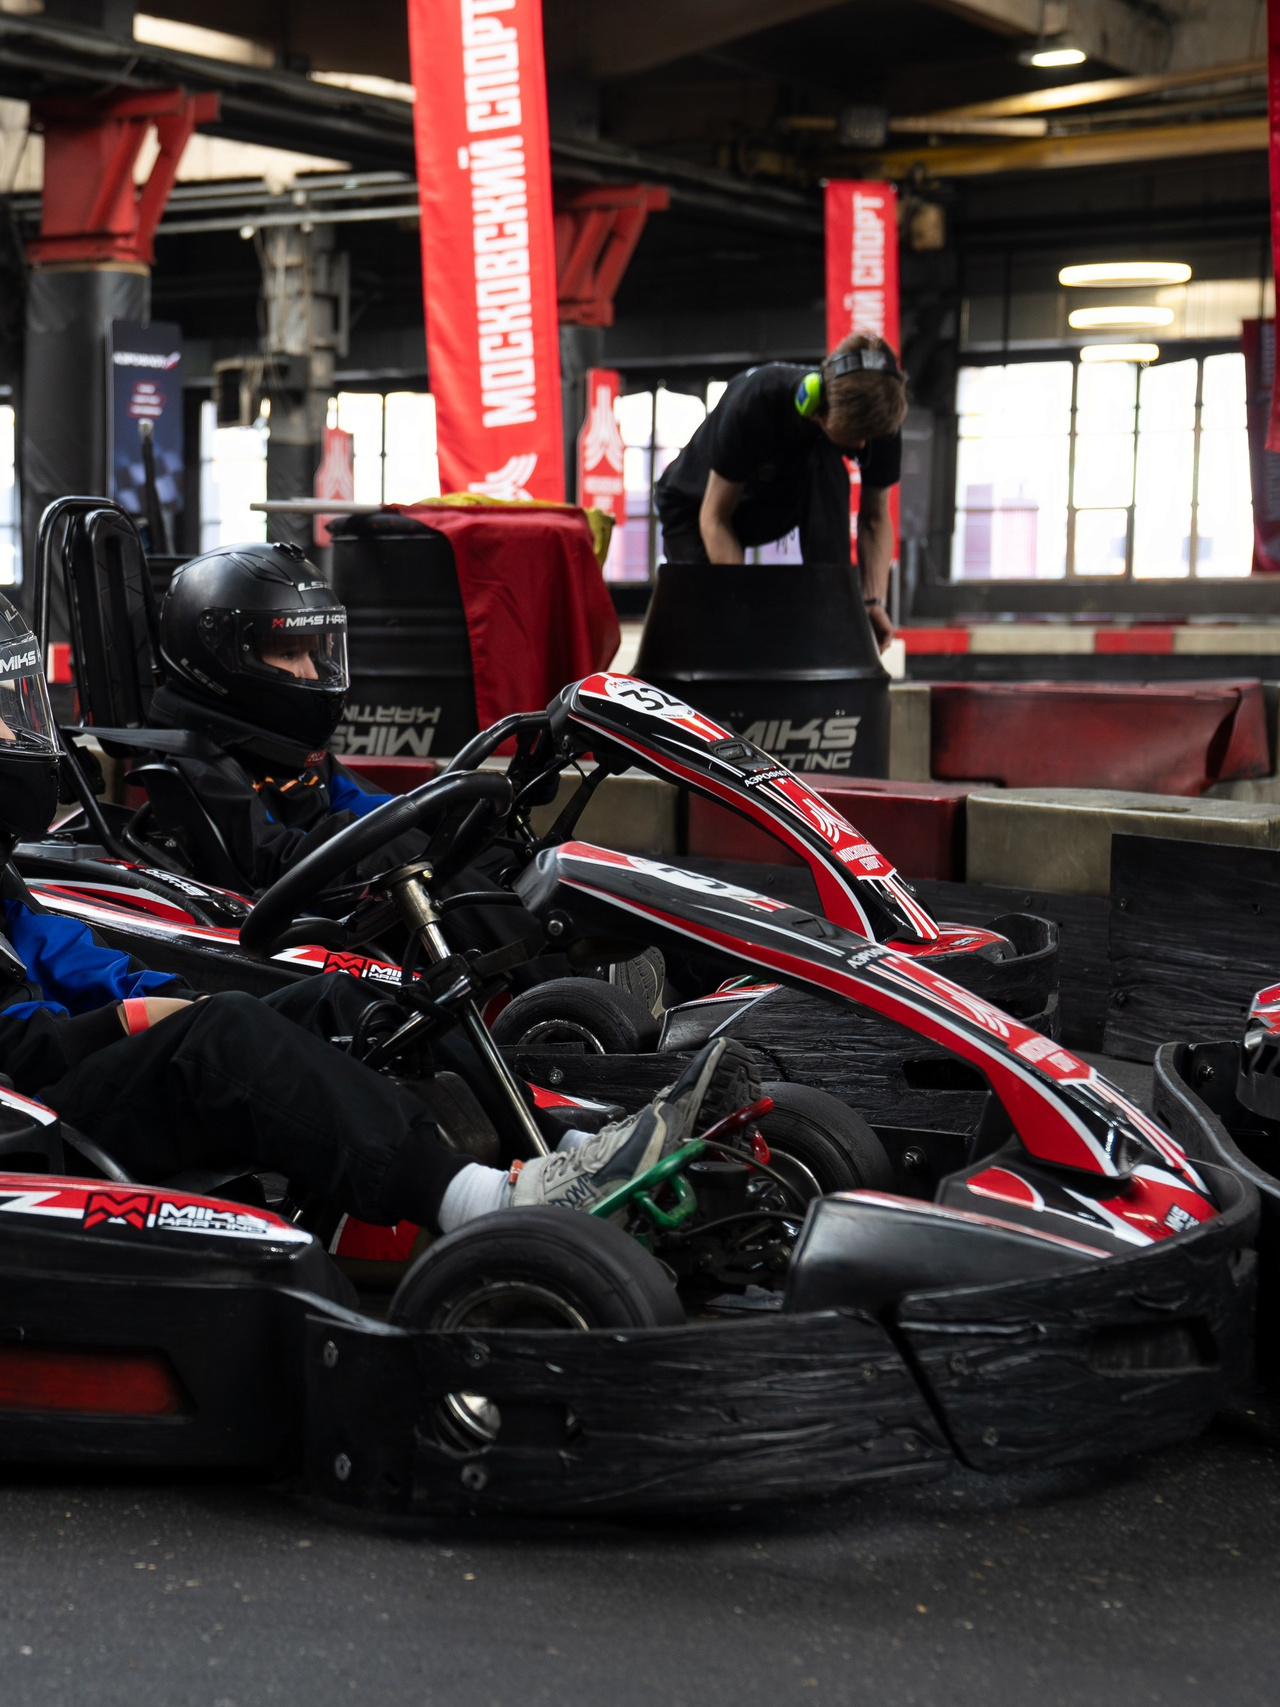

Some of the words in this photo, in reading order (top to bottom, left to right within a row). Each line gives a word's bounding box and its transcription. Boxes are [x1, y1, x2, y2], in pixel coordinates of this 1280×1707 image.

[461, 0, 522, 133] СПОРТ
[851, 191, 885, 286] СПОРТ
[458, 135, 537, 428] МОСКОВСКИЙ
[286, 616, 324, 628] MIKS
[342, 704, 442, 725] KARTIN
[157, 1216, 269, 1235] KARTING
[159, 1202, 269, 1230] MIKS
